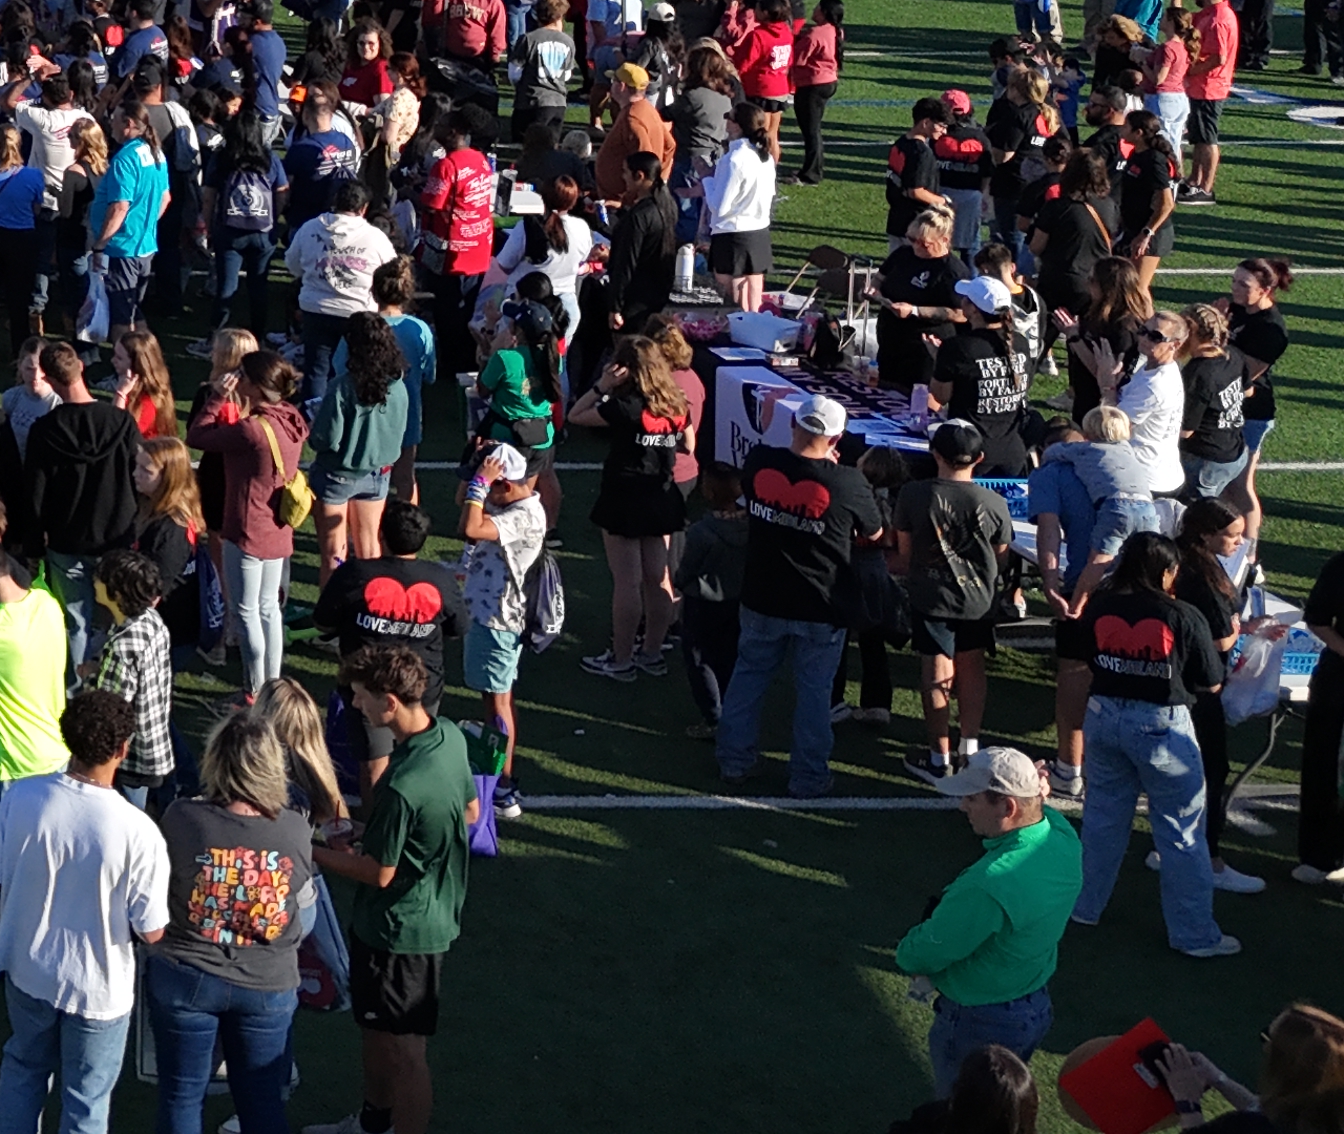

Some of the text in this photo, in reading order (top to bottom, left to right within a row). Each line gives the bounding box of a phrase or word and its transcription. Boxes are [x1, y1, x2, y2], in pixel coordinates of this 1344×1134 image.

[203, 866, 282, 886] THE DAY
[192, 889, 229, 909] HAS
